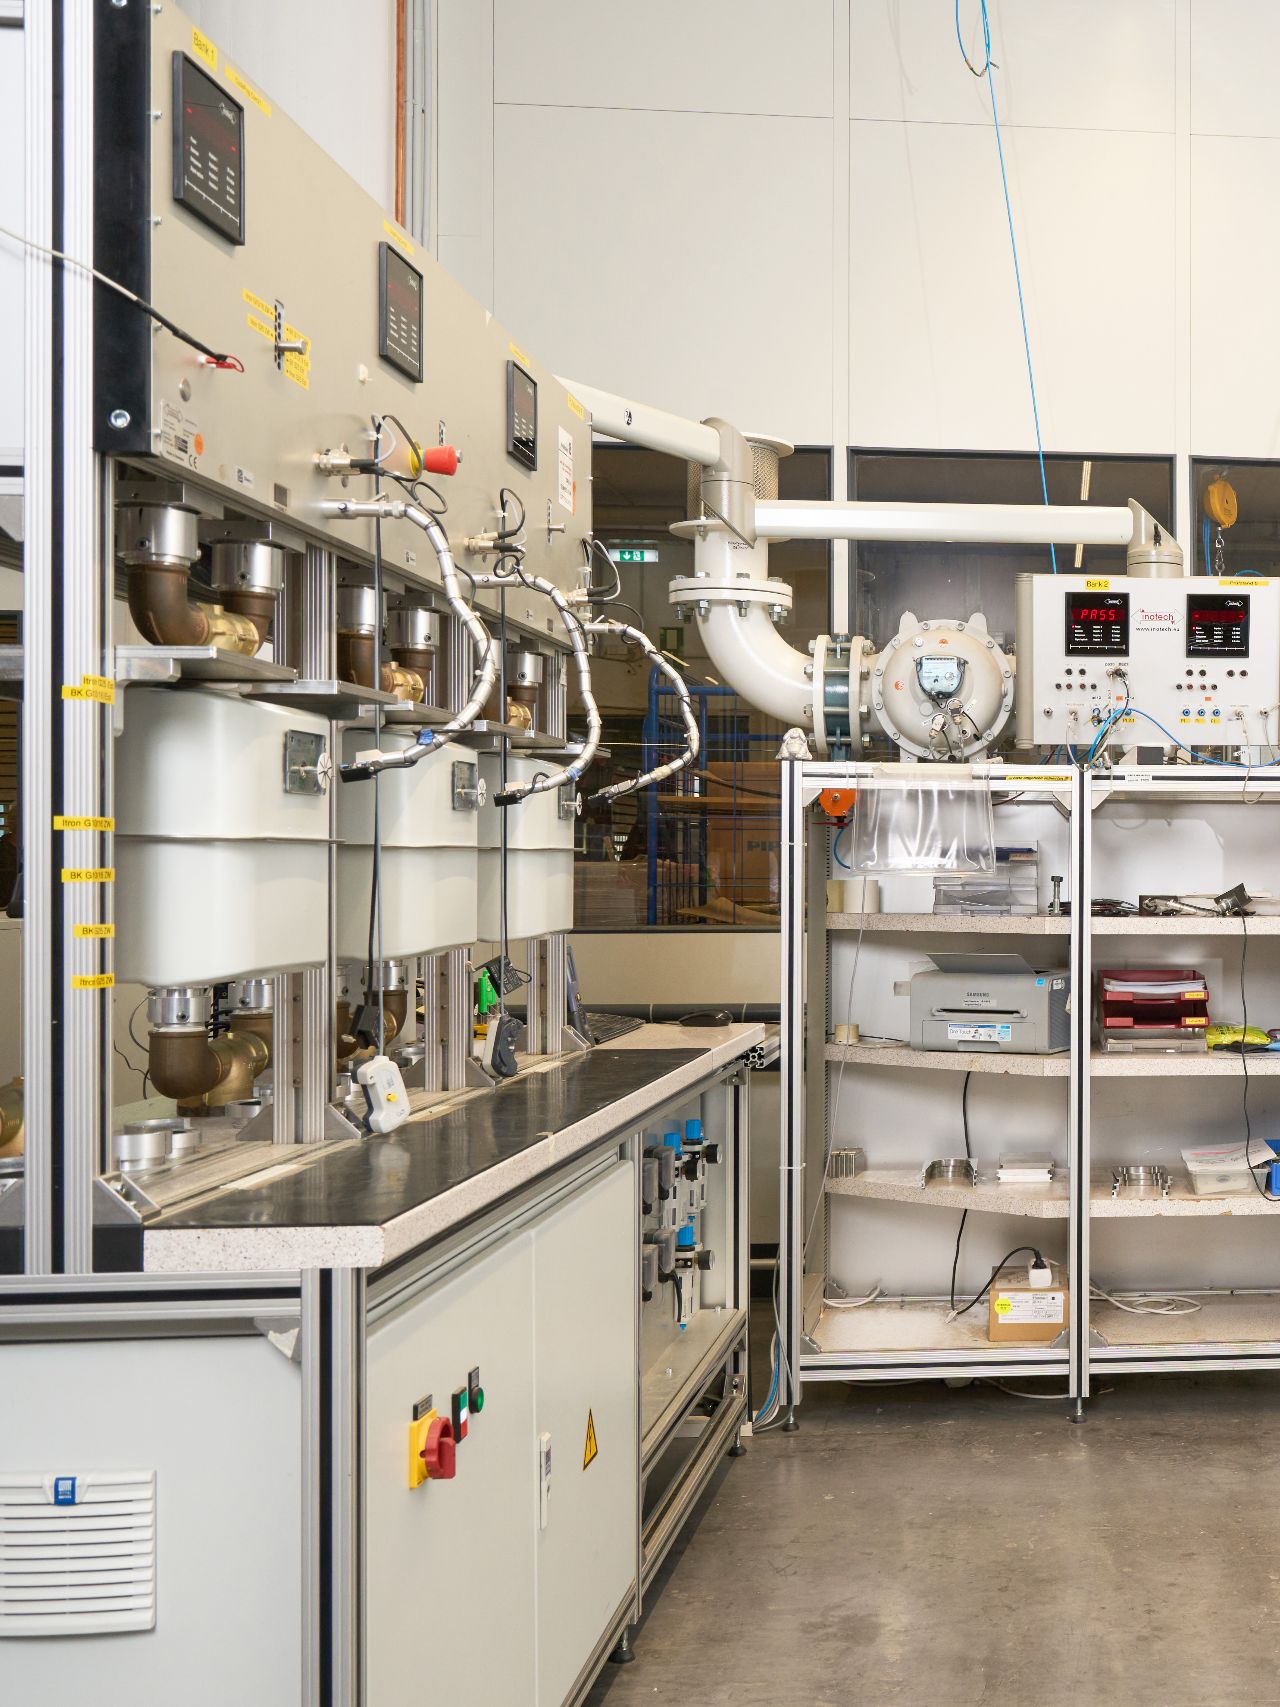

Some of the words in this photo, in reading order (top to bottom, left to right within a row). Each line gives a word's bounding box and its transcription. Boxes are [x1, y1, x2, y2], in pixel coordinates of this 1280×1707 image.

[193, 31, 209, 57] Bank
[1081, 609, 1116, 621] PASS
[1142, 611, 1174, 621] inotech
[70, 688, 83, 697] BK
[62, 818, 81, 827] Itron
[70, 871, 82, 880] BK
[82, 927, 93, 935] BK
